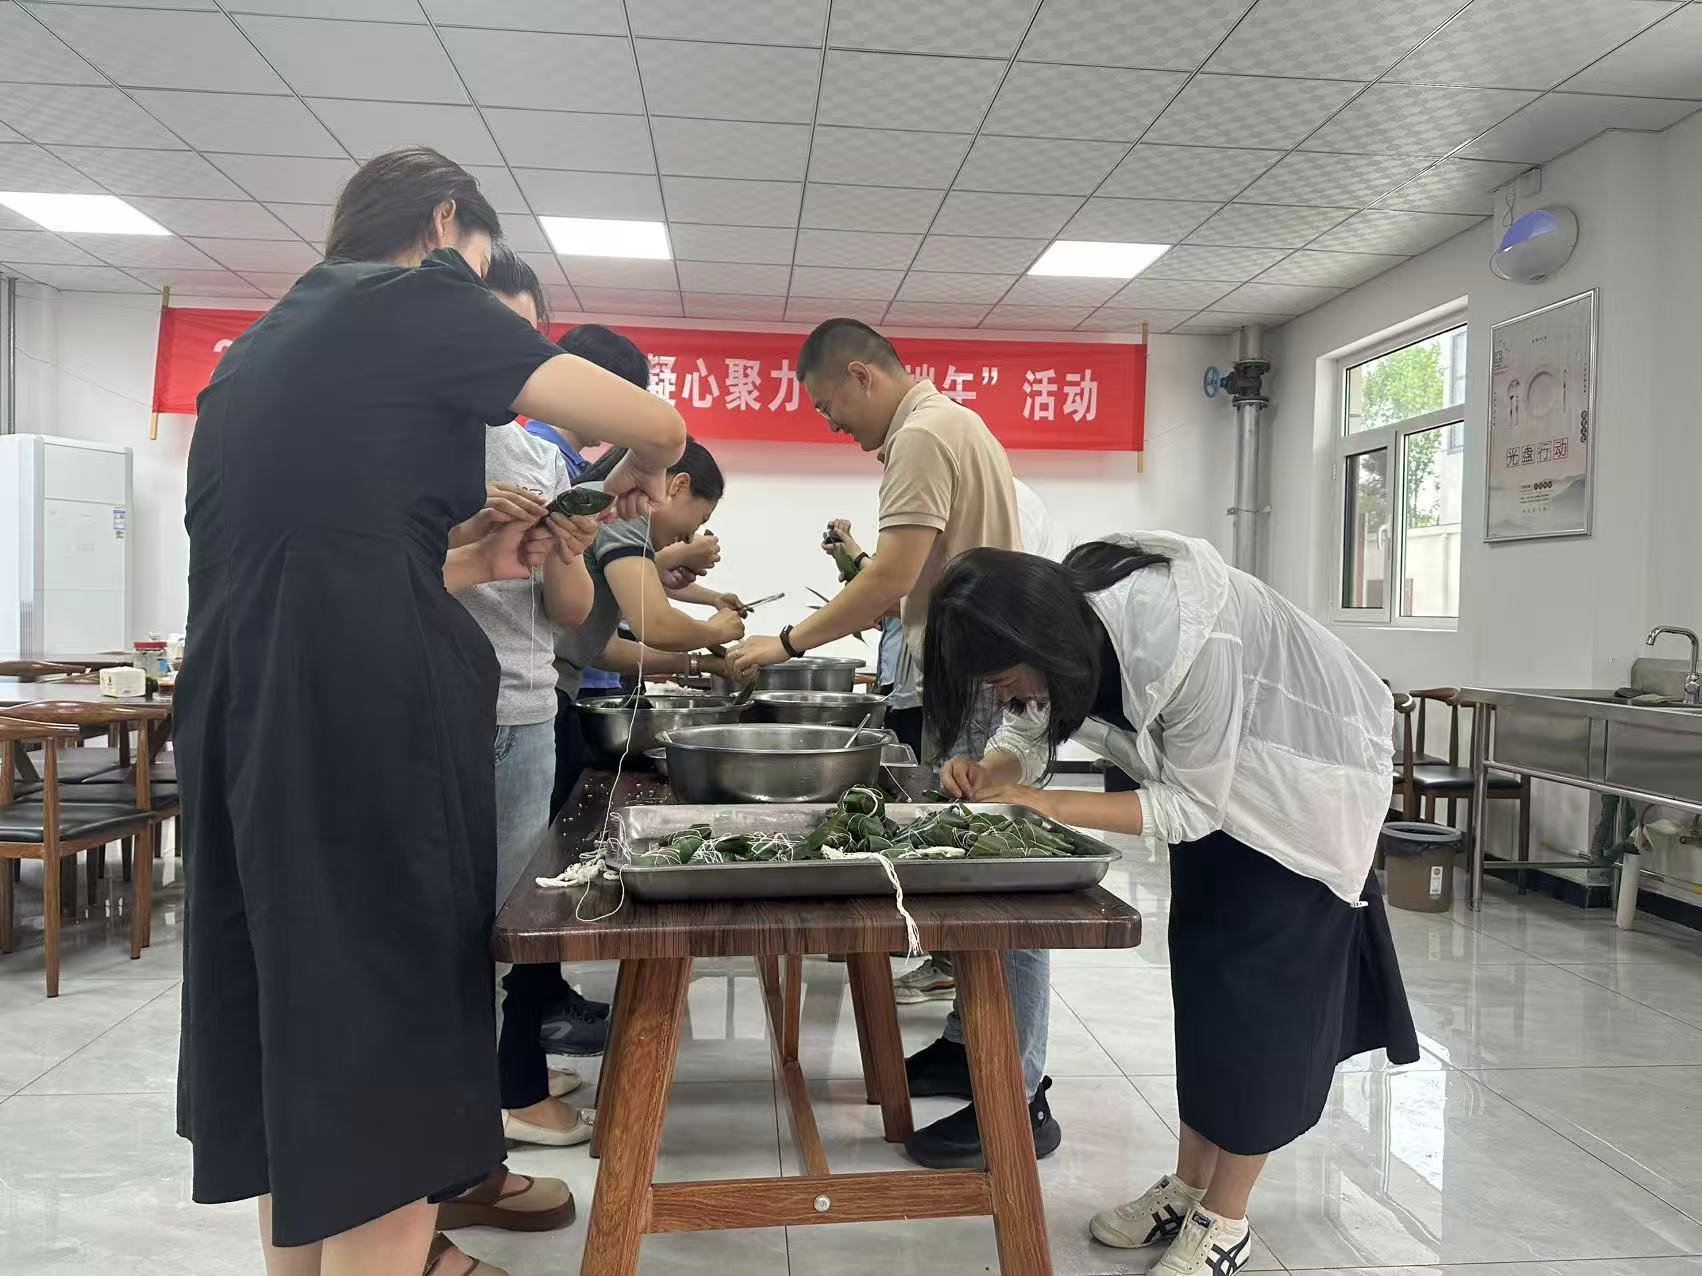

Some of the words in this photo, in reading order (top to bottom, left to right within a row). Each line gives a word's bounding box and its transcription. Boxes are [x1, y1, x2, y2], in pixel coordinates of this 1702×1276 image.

[1022, 369, 1098, 422] 活动
[1506, 439, 1568, 468] 光盘行动
